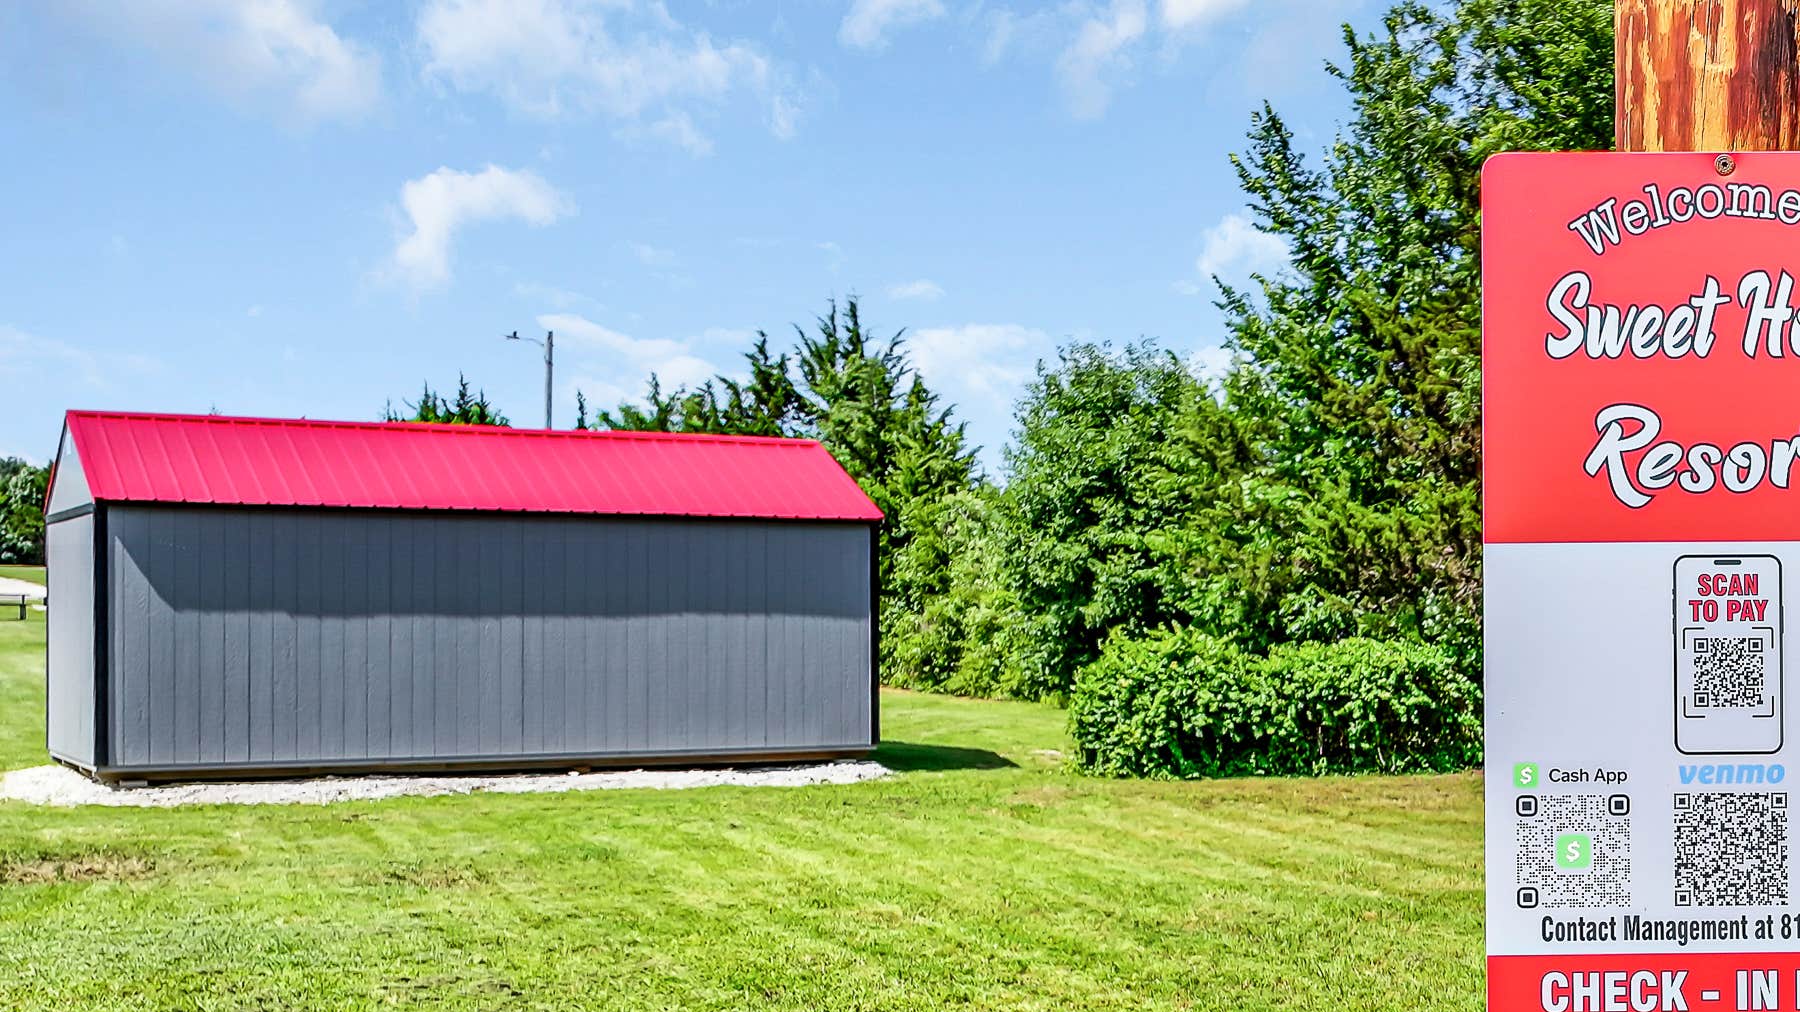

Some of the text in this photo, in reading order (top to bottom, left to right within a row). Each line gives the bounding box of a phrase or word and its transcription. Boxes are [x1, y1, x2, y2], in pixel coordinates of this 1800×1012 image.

[1545, 271, 1732, 360] Sweet
[1697, 573, 1760, 597] SCAN
[1689, 599, 1769, 623] TO PAY
[1548, 768, 1628, 786] Cash App
[1678, 763, 1785, 785] venmo
[1541, 915, 1617, 943] Contact
[1623, 914, 1748, 946] Management
[1754, 914, 1774, 940] at
[1736, 970, 1779, 1011] IN
